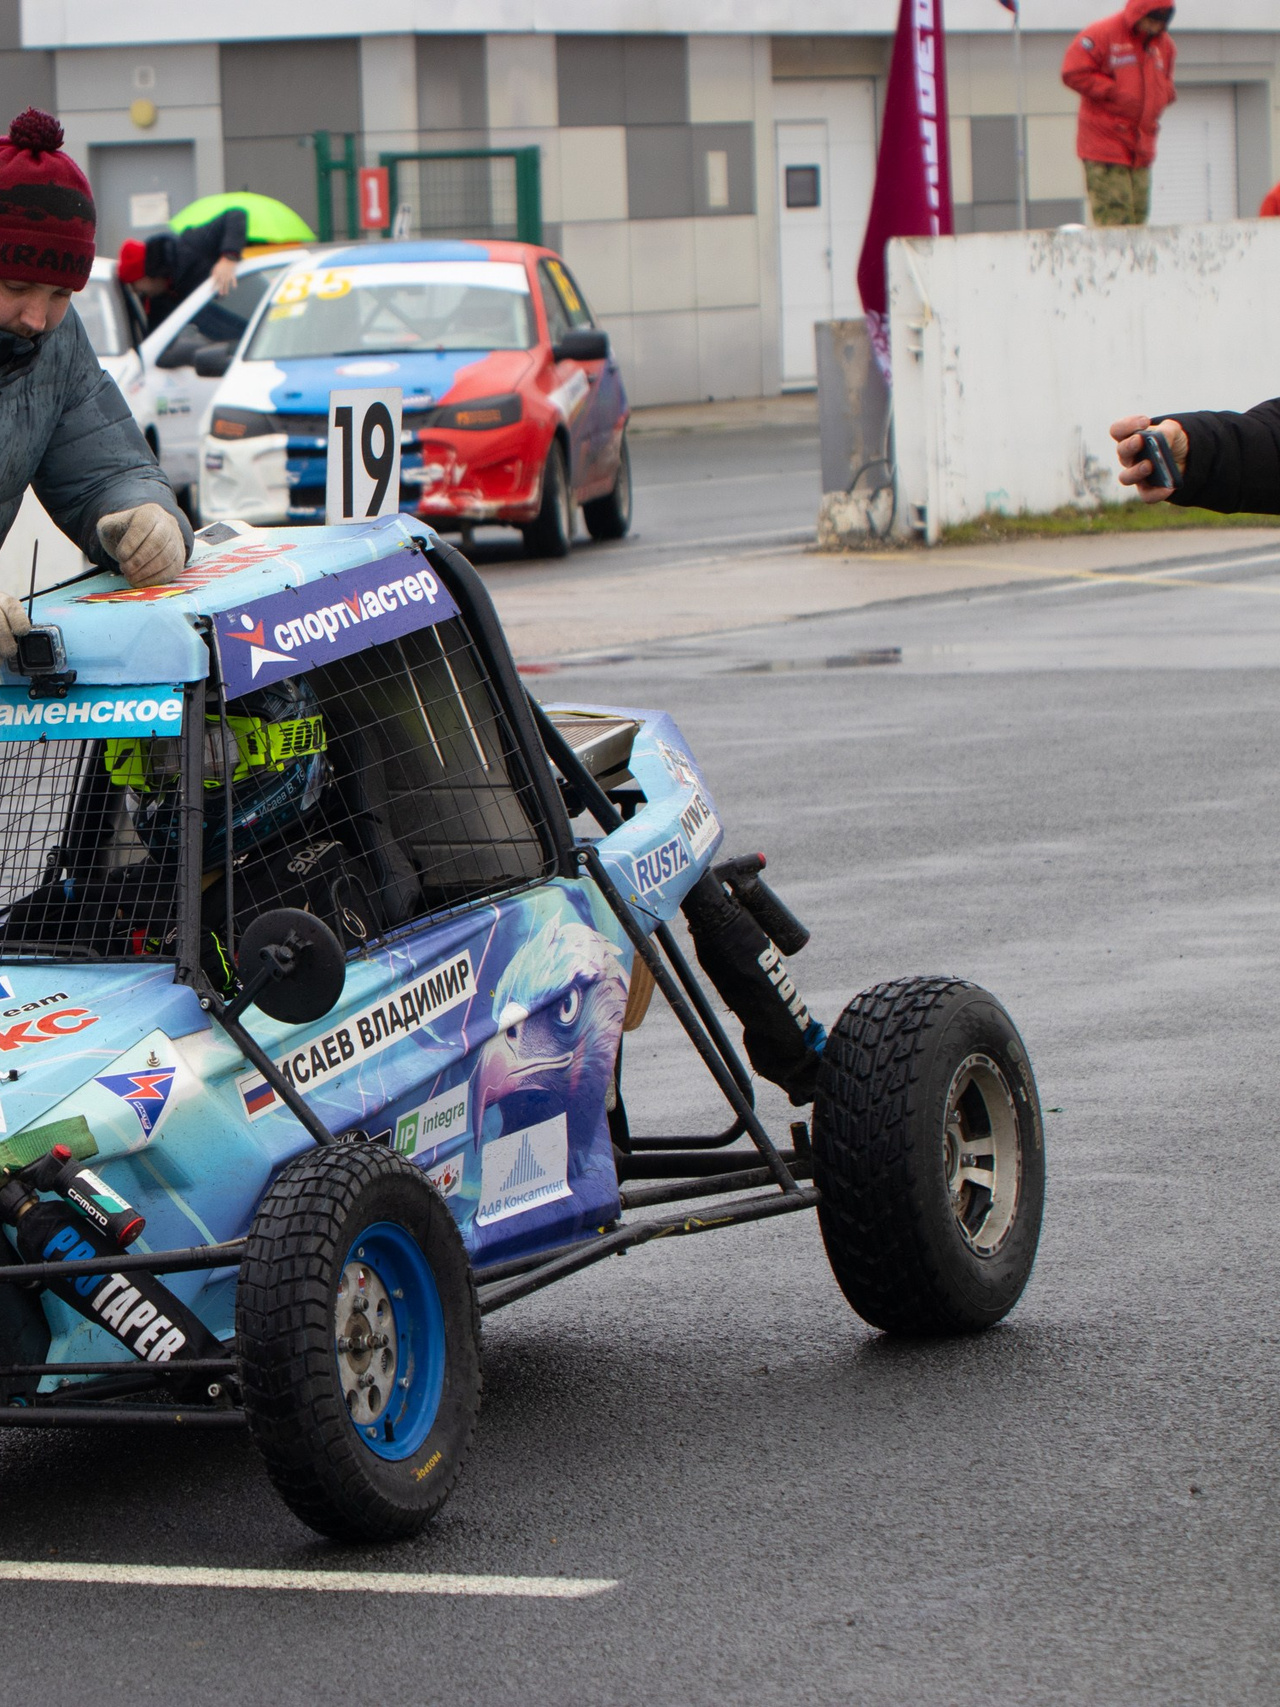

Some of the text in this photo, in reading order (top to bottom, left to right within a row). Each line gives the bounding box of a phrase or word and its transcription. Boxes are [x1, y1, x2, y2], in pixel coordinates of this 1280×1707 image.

[276, 267, 359, 305] 85
[334, 401, 396, 518] 19
[635, 835, 689, 894] RUSTA
[356, 958, 471, 1051] ВЛАДИМИР
[399, 1101, 466, 1151] IP integra
[66, 1187, 109, 1227] CFMOTO
[479, 1179, 565, 1219] АДВ Консалтинг
